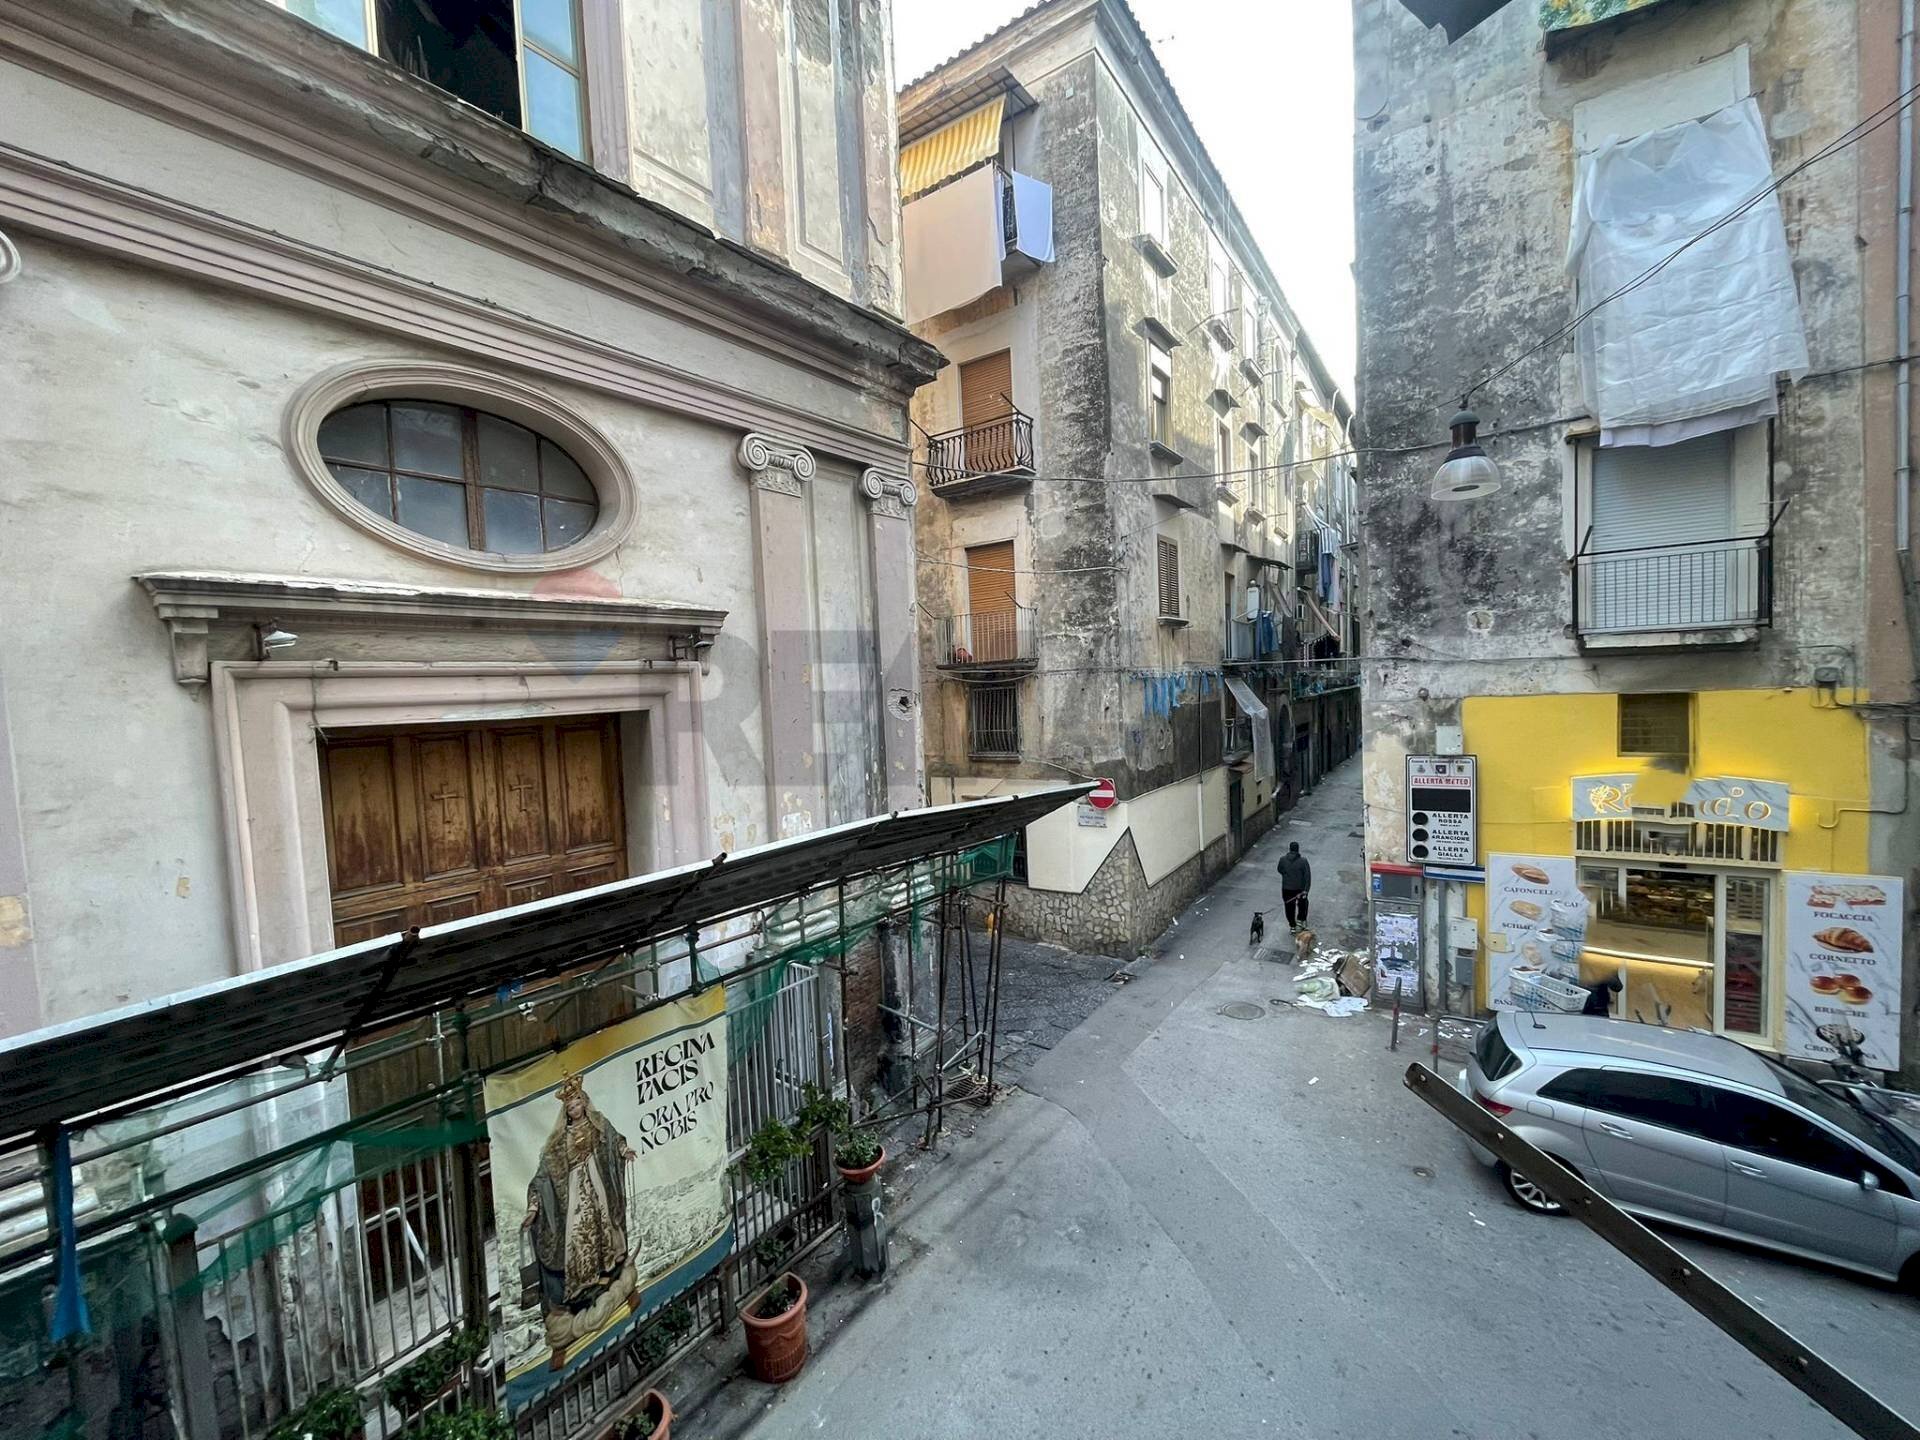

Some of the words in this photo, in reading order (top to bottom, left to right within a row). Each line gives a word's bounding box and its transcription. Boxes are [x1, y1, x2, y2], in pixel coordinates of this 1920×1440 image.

[1813, 911, 1874, 922] FOCACCIA
[1809, 952, 1876, 966] CORNETTO
[635, 1032, 715, 1082] REGINA
[637, 1059, 699, 1105] PACIS
[639, 1101, 682, 1133] ORA
[685, 1081, 714, 1113] PRO
[640, 1110, 698, 1155] NOBIS
